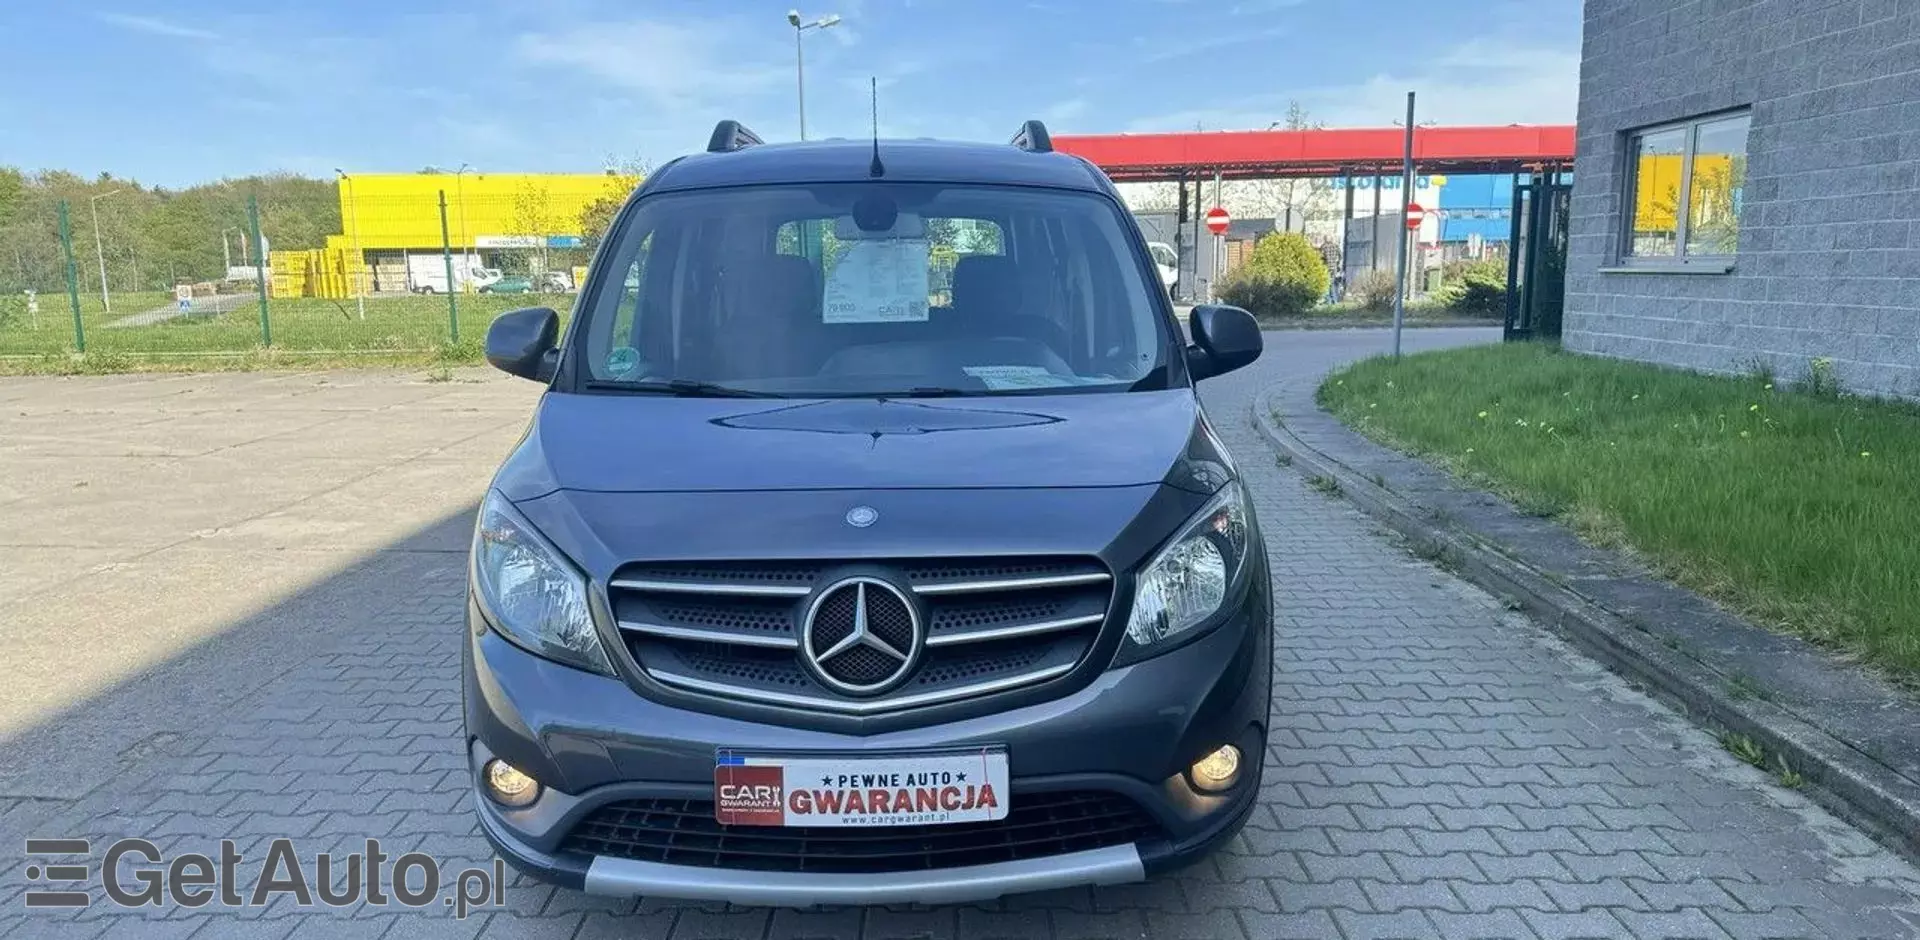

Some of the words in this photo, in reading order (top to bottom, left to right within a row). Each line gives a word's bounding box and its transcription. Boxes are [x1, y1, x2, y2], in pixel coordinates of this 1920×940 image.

[838, 773, 900, 788] PEWNE
[906, 771, 951, 787] AUTO
[720, 785, 771, 799] CAR
[720, 799, 771, 808] GWARANT
[789, 784, 998, 815] GWARANCJA
[841, 812, 950, 825] www.cargwarant.pl
